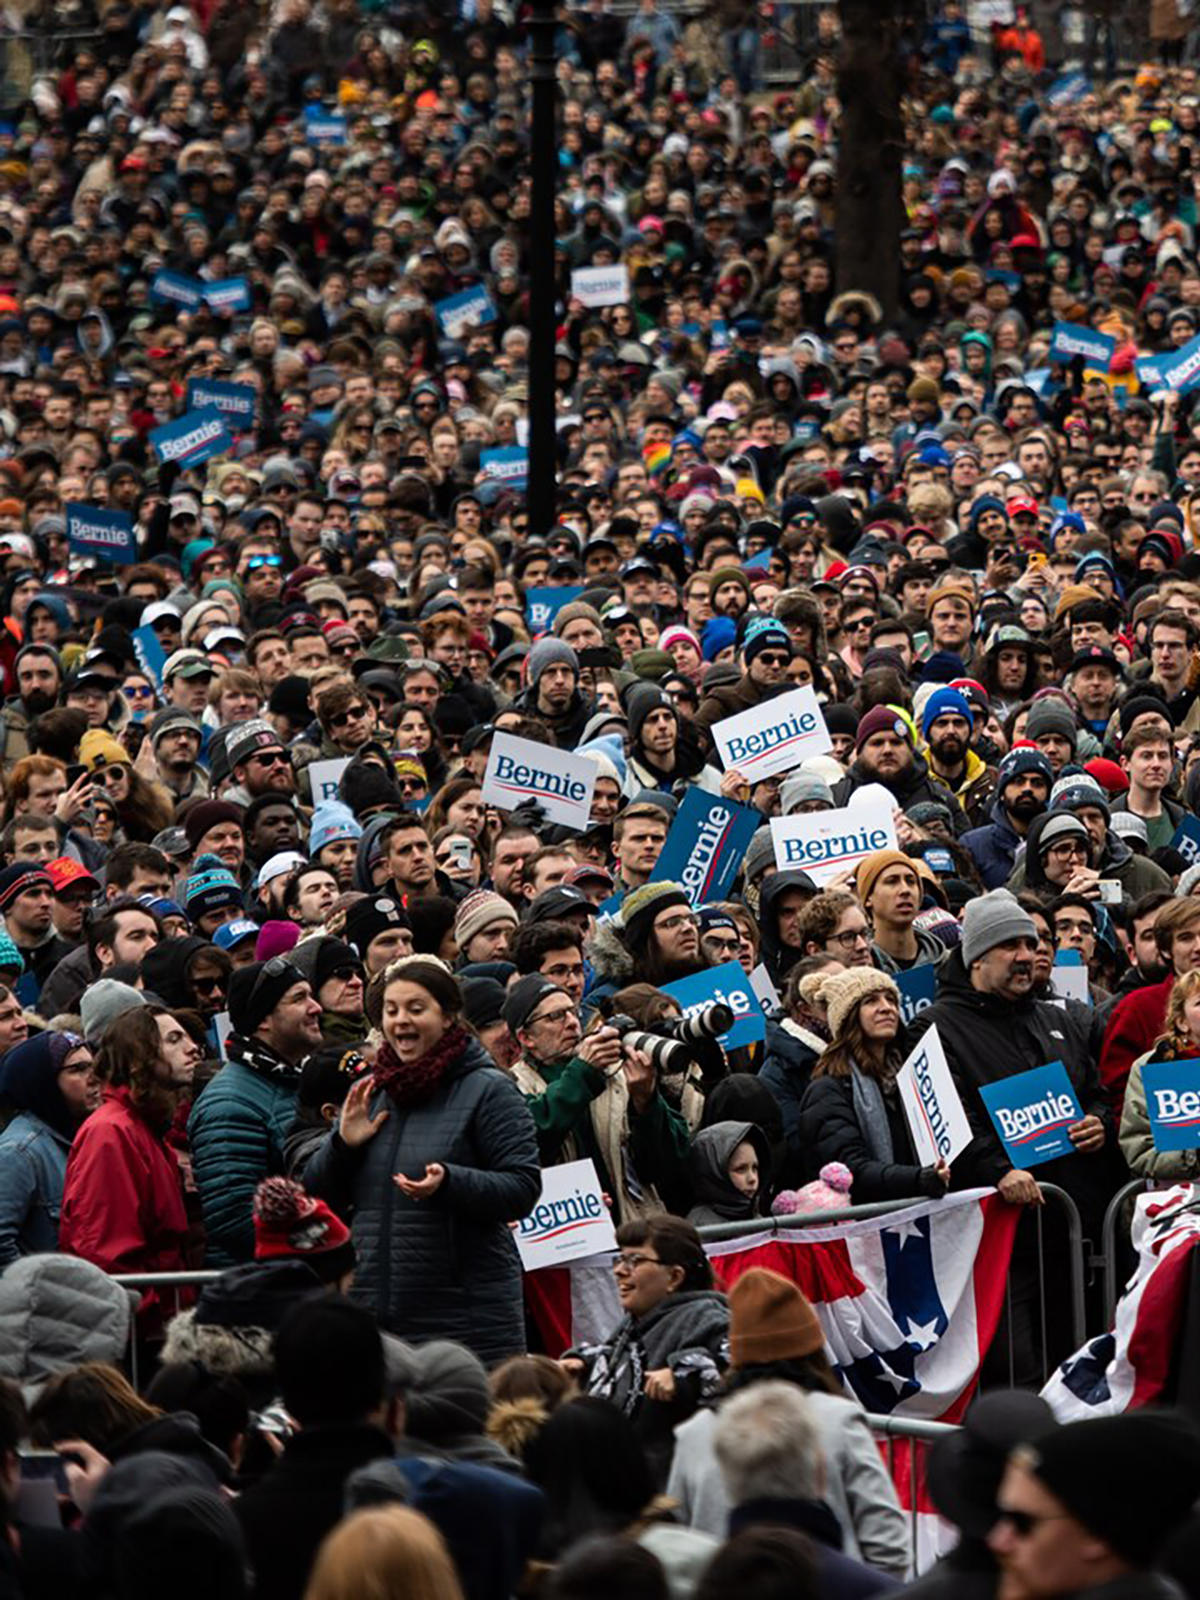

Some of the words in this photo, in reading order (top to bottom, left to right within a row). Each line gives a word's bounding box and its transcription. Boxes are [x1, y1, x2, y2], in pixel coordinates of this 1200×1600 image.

[1056, 332, 1111, 361] Bernie
[160, 418, 223, 462] Bernie
[483, 460, 528, 479] Bern
[70, 518, 130, 546] Bernie
[726, 711, 818, 762] Bernie
[494, 754, 587, 801] Bernie
[783, 826, 889, 863] Bernie
[913, 1054, 952, 1156] Bernie
[995, 1090, 1075, 1139] Bernie
